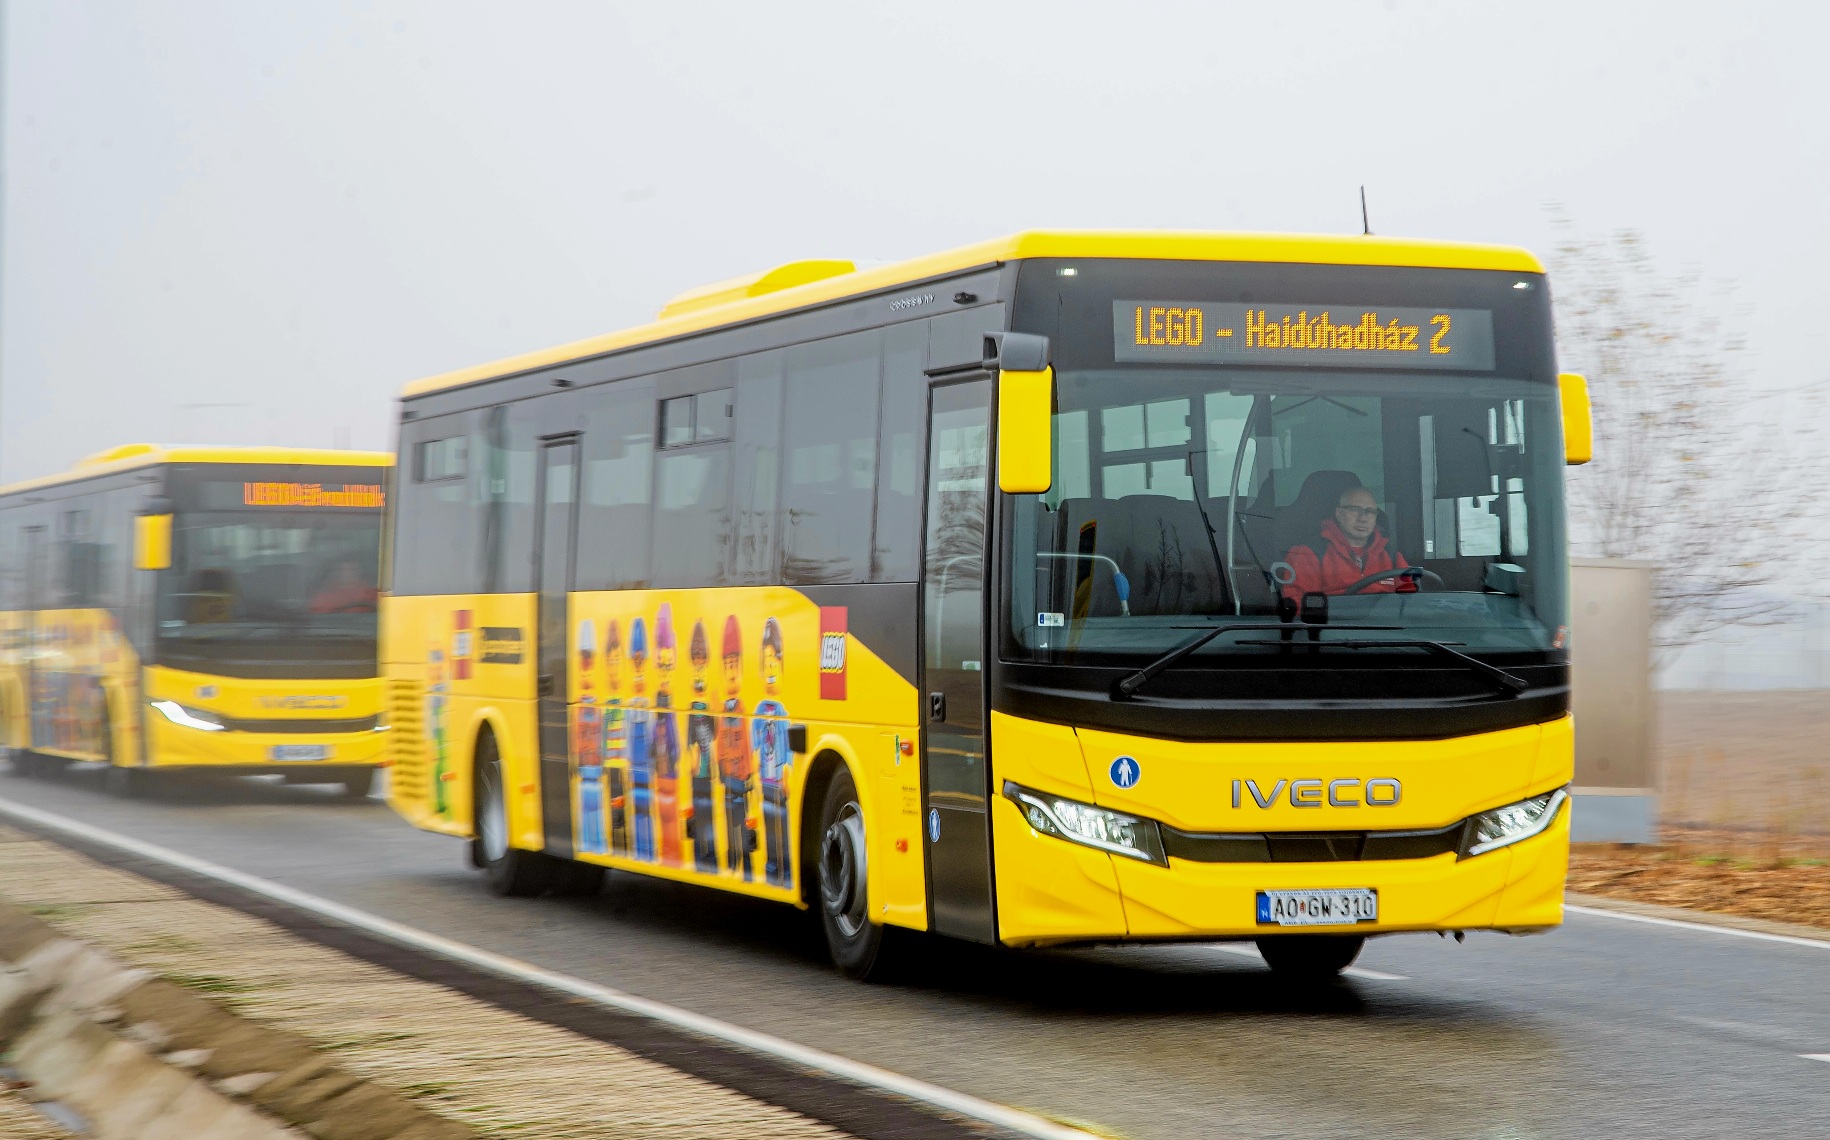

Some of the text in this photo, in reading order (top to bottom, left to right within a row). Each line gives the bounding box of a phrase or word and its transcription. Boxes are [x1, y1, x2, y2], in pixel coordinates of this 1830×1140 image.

[1134, 306, 1203, 346] LEGO
[1428, 313, 1452, 354] 2
[1231, 778, 1402, 809] IVECO
